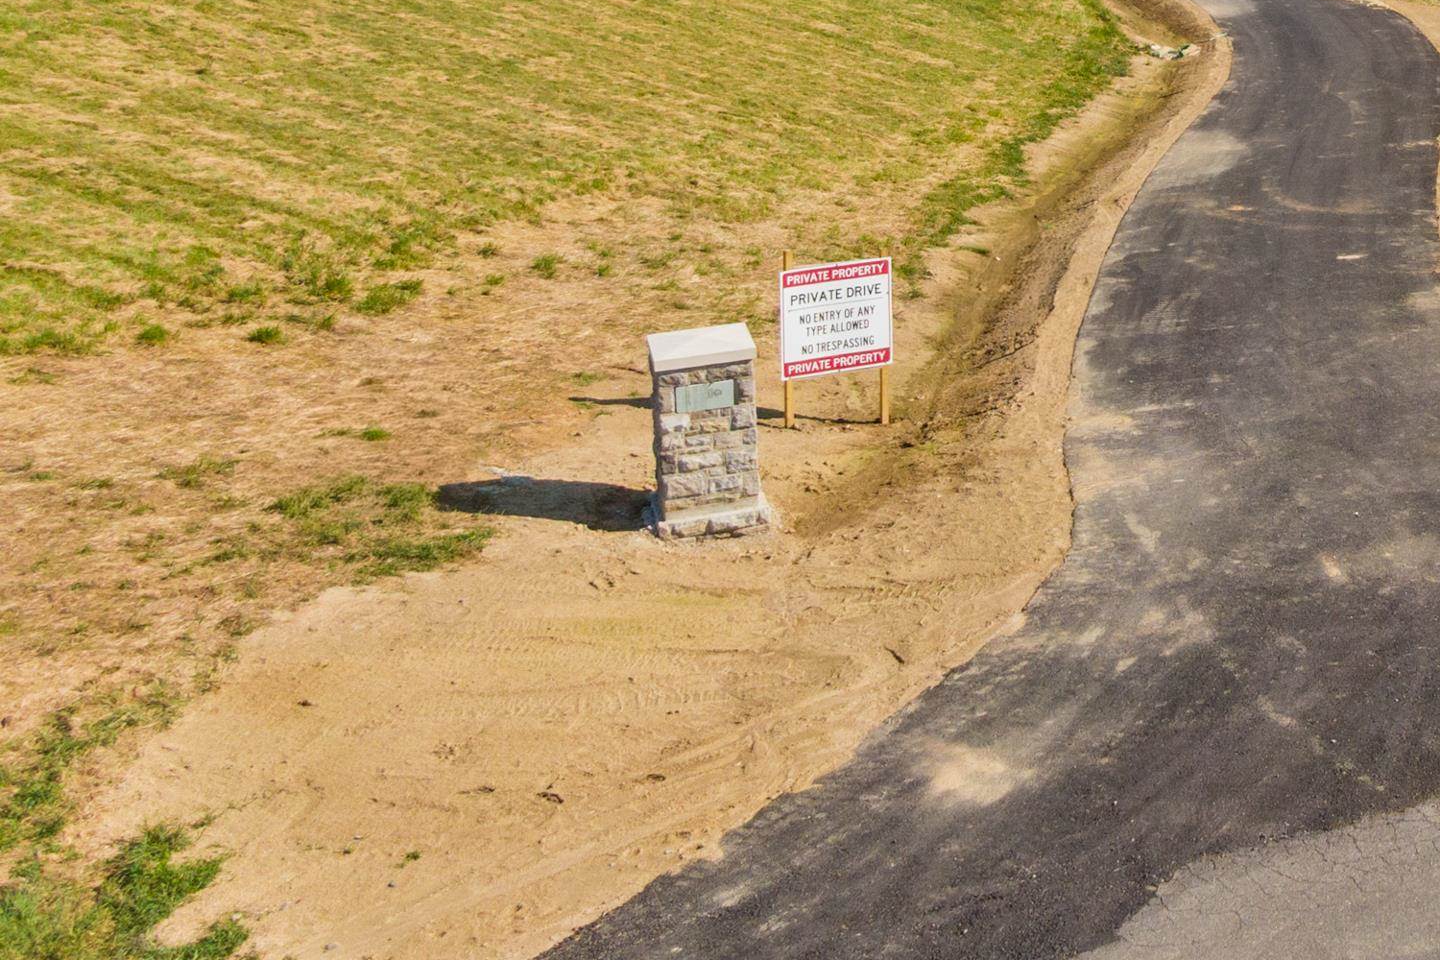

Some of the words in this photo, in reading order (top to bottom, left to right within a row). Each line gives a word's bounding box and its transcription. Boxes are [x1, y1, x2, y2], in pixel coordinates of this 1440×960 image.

[787, 271, 829, 285] PRIVATE
[832, 262, 884, 279] PROPERTY
[790, 289, 842, 306] PRIVATE
[847, 283, 881, 297] DRIVE
[800, 314, 811, 324] NO
[814, 309, 841, 322] ENTRY
[845, 308, 854, 318] OF
[858, 305, 875, 316] ANY
[807, 325, 827, 336] TYPE
[831, 320, 869, 333] ALLOWED
[802, 344, 813, 354] NO
[817, 336, 874, 352] TRESPASSING
[788, 360, 831, 374] PRIVATE
[834, 351, 886, 368] PROPERTY
